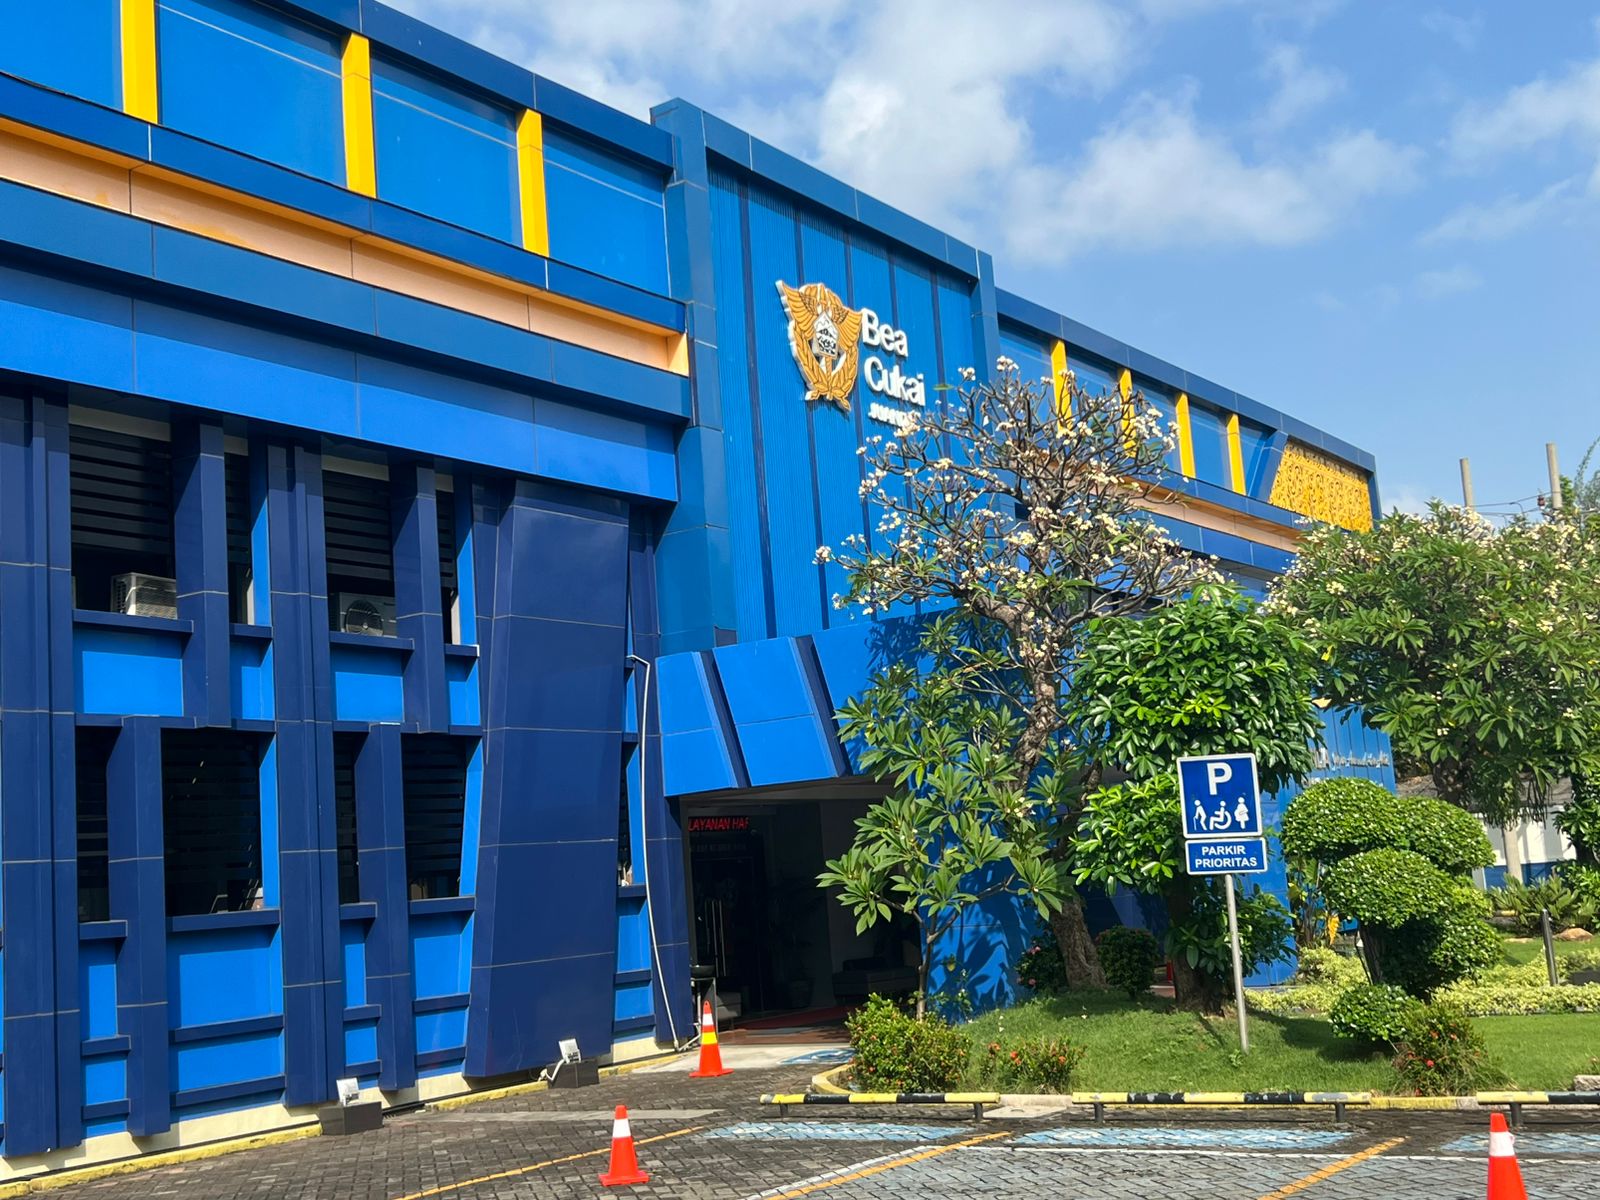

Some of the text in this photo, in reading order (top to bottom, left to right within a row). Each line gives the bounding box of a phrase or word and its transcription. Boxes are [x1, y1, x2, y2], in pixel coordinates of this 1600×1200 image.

[861, 307, 908, 357] Bea
[864, 356, 926, 406] Cukai
[1207, 762, 1232, 795] P
[688, 817, 731, 832] LAYANAN
[1195, 857, 1258, 868] PRIORITAS
[1201, 845, 1246, 856] PARKIR
